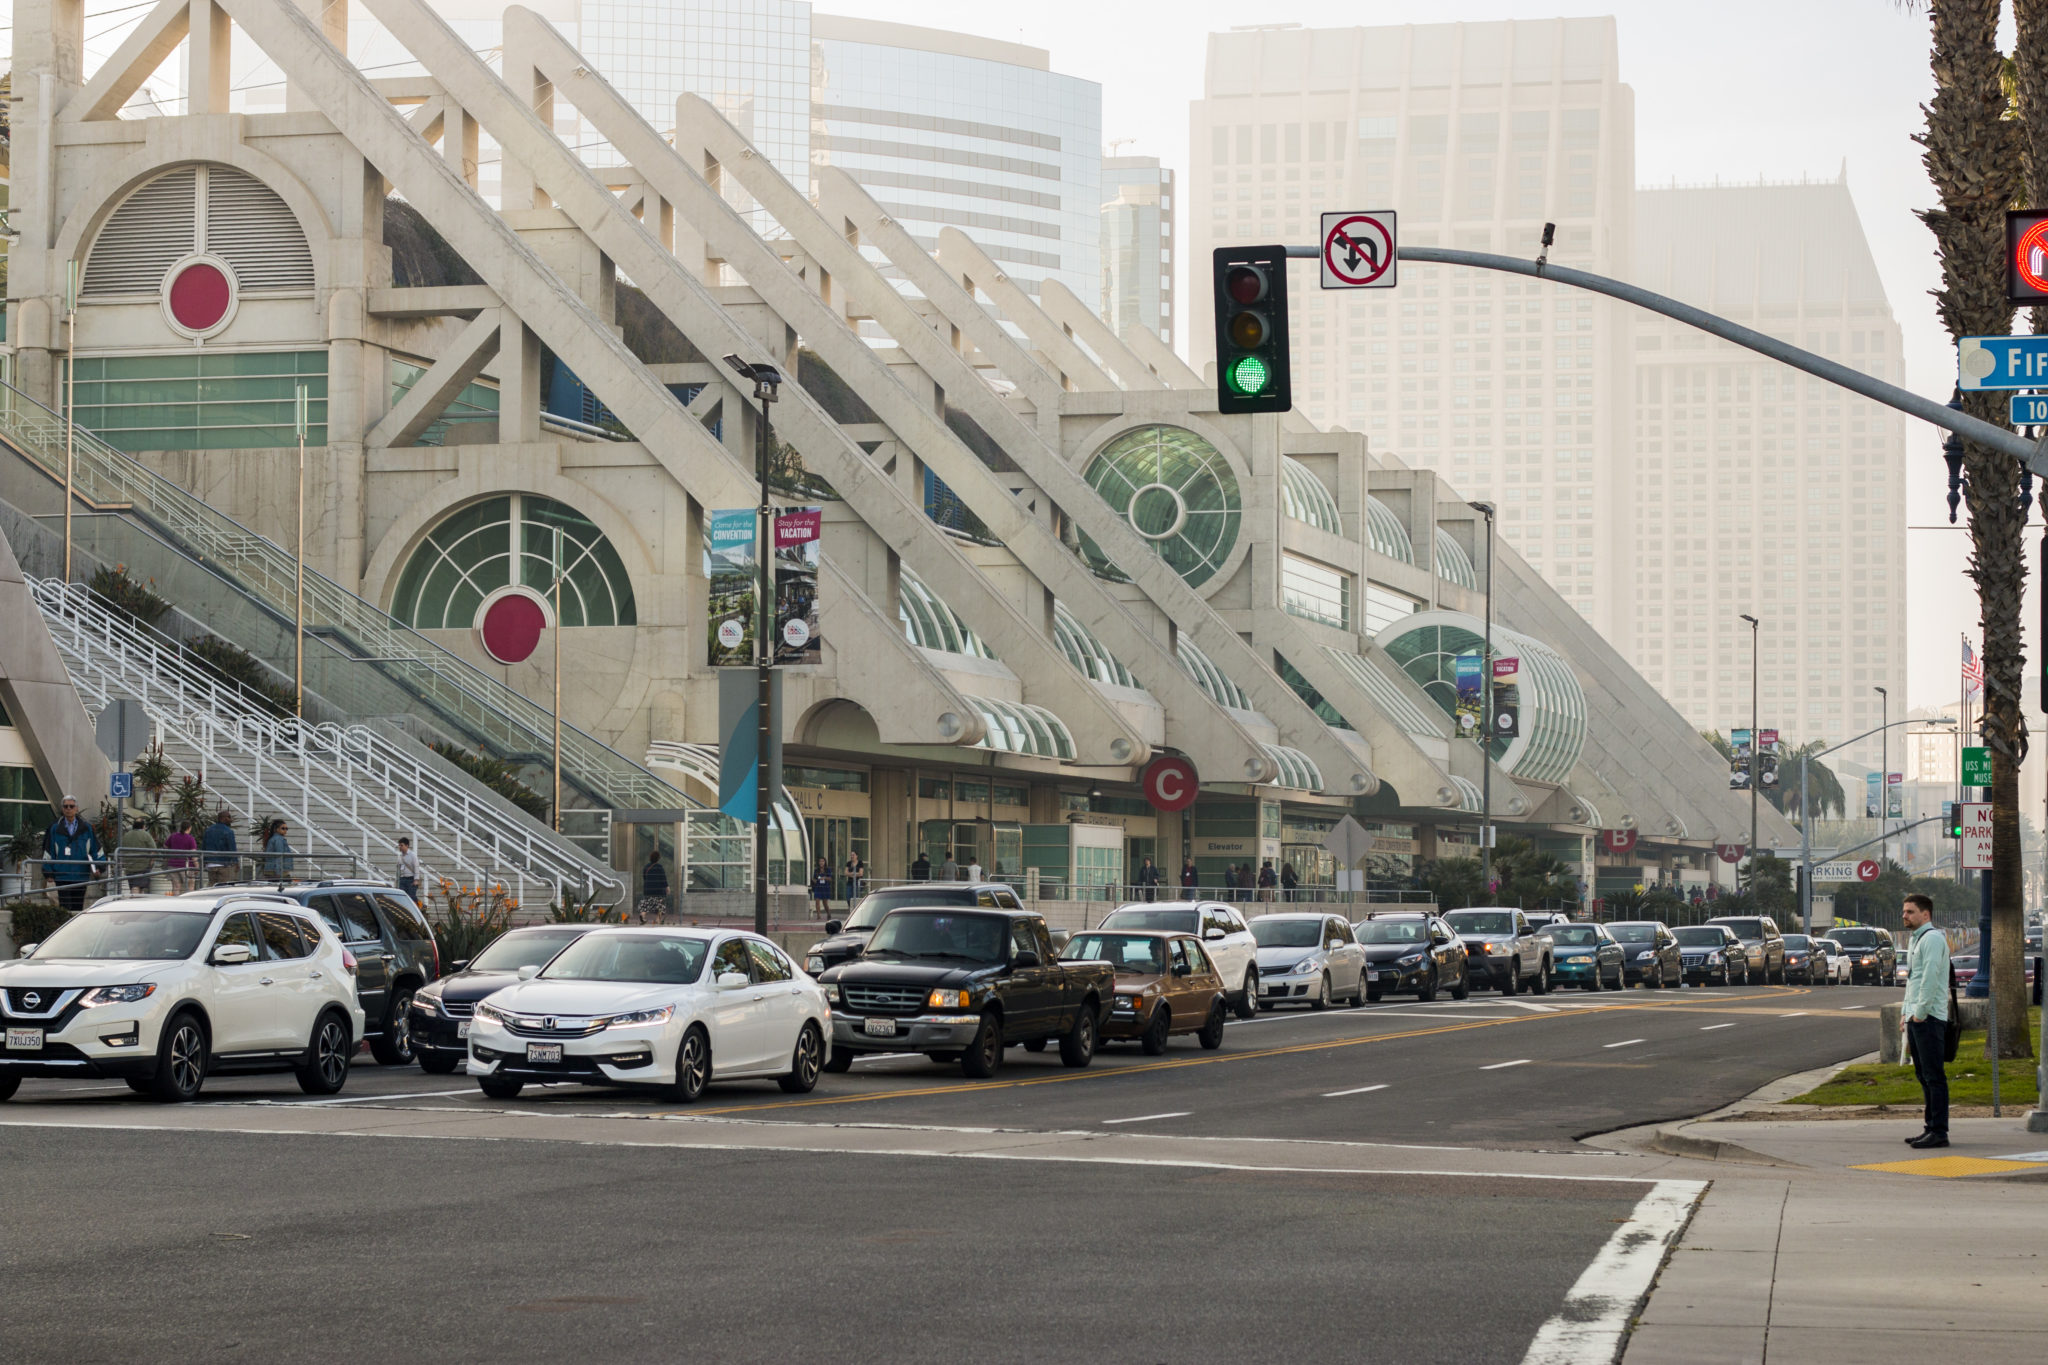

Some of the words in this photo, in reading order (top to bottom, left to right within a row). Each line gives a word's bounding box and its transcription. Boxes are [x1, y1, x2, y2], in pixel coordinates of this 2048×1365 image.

[2008, 348, 2048, 377] FIF
[2028, 401, 2048, 420] 10
[714, 521, 732, 529] Come
[732, 520, 742, 529] for
[743, 520, 753, 528] the
[778, 520, 793, 529] Stay
[793, 519, 803, 528] for
[804, 518, 816, 526] the
[713, 529, 753, 540] CONVENTION
[780, 528, 812, 538] VACATION
[1965, 760, 1979, 771] USS
[1156, 768, 1184, 801] C
[794, 791, 813, 810] HALL
[816, 792, 823, 810] C
[1612, 829, 1629, 846] B
[1207, 843, 1243, 851] Elevator
[1723, 844, 1738, 857] A
[9, 1036, 41, 1046] 7XUJ350
